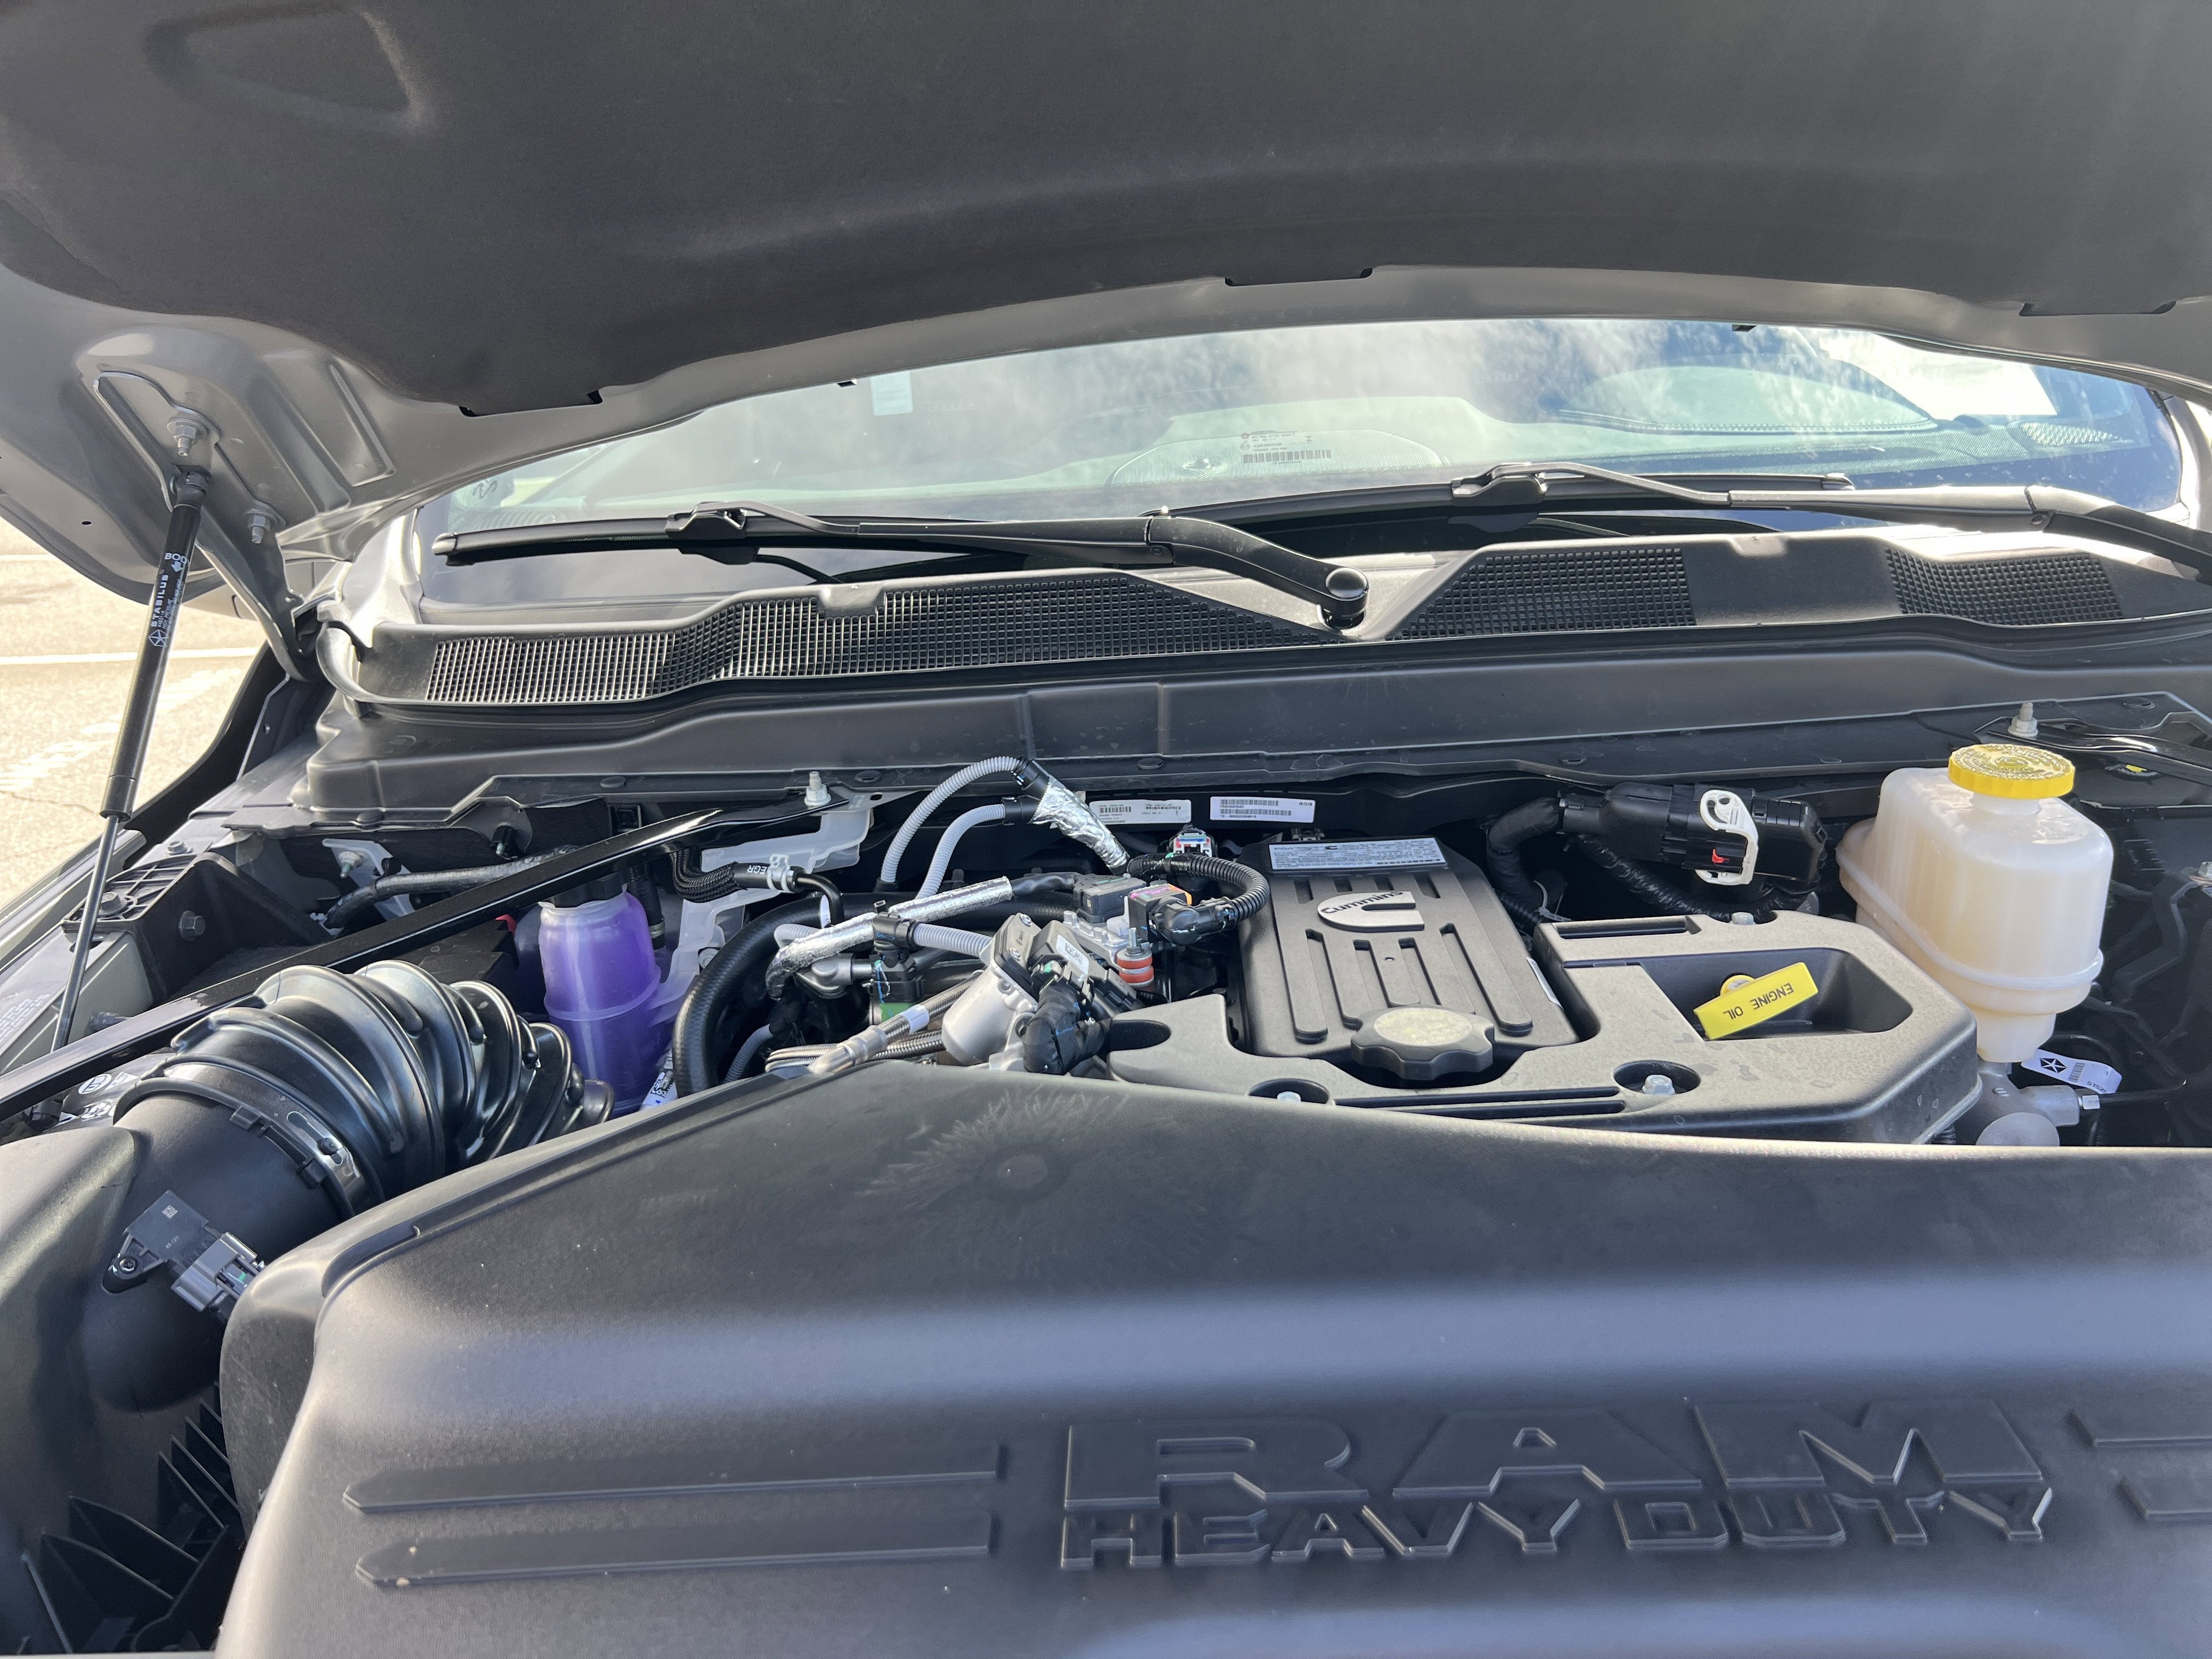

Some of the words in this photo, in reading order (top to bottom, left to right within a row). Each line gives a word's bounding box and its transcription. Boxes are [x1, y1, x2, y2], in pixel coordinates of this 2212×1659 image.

[151, 574, 168, 627] STABILUS
[747, 865, 767, 874] EGR
[1321, 891, 1403, 914] Cummins
[1750, 982, 1795, 1010] ENGINE
[1723, 1006, 1743, 1020] OIL
[1063, 1401, 2044, 1510] RAM
[1060, 1498, 1581, 1568] HEAVY
[1613, 1487, 2053, 1549] DUTY
